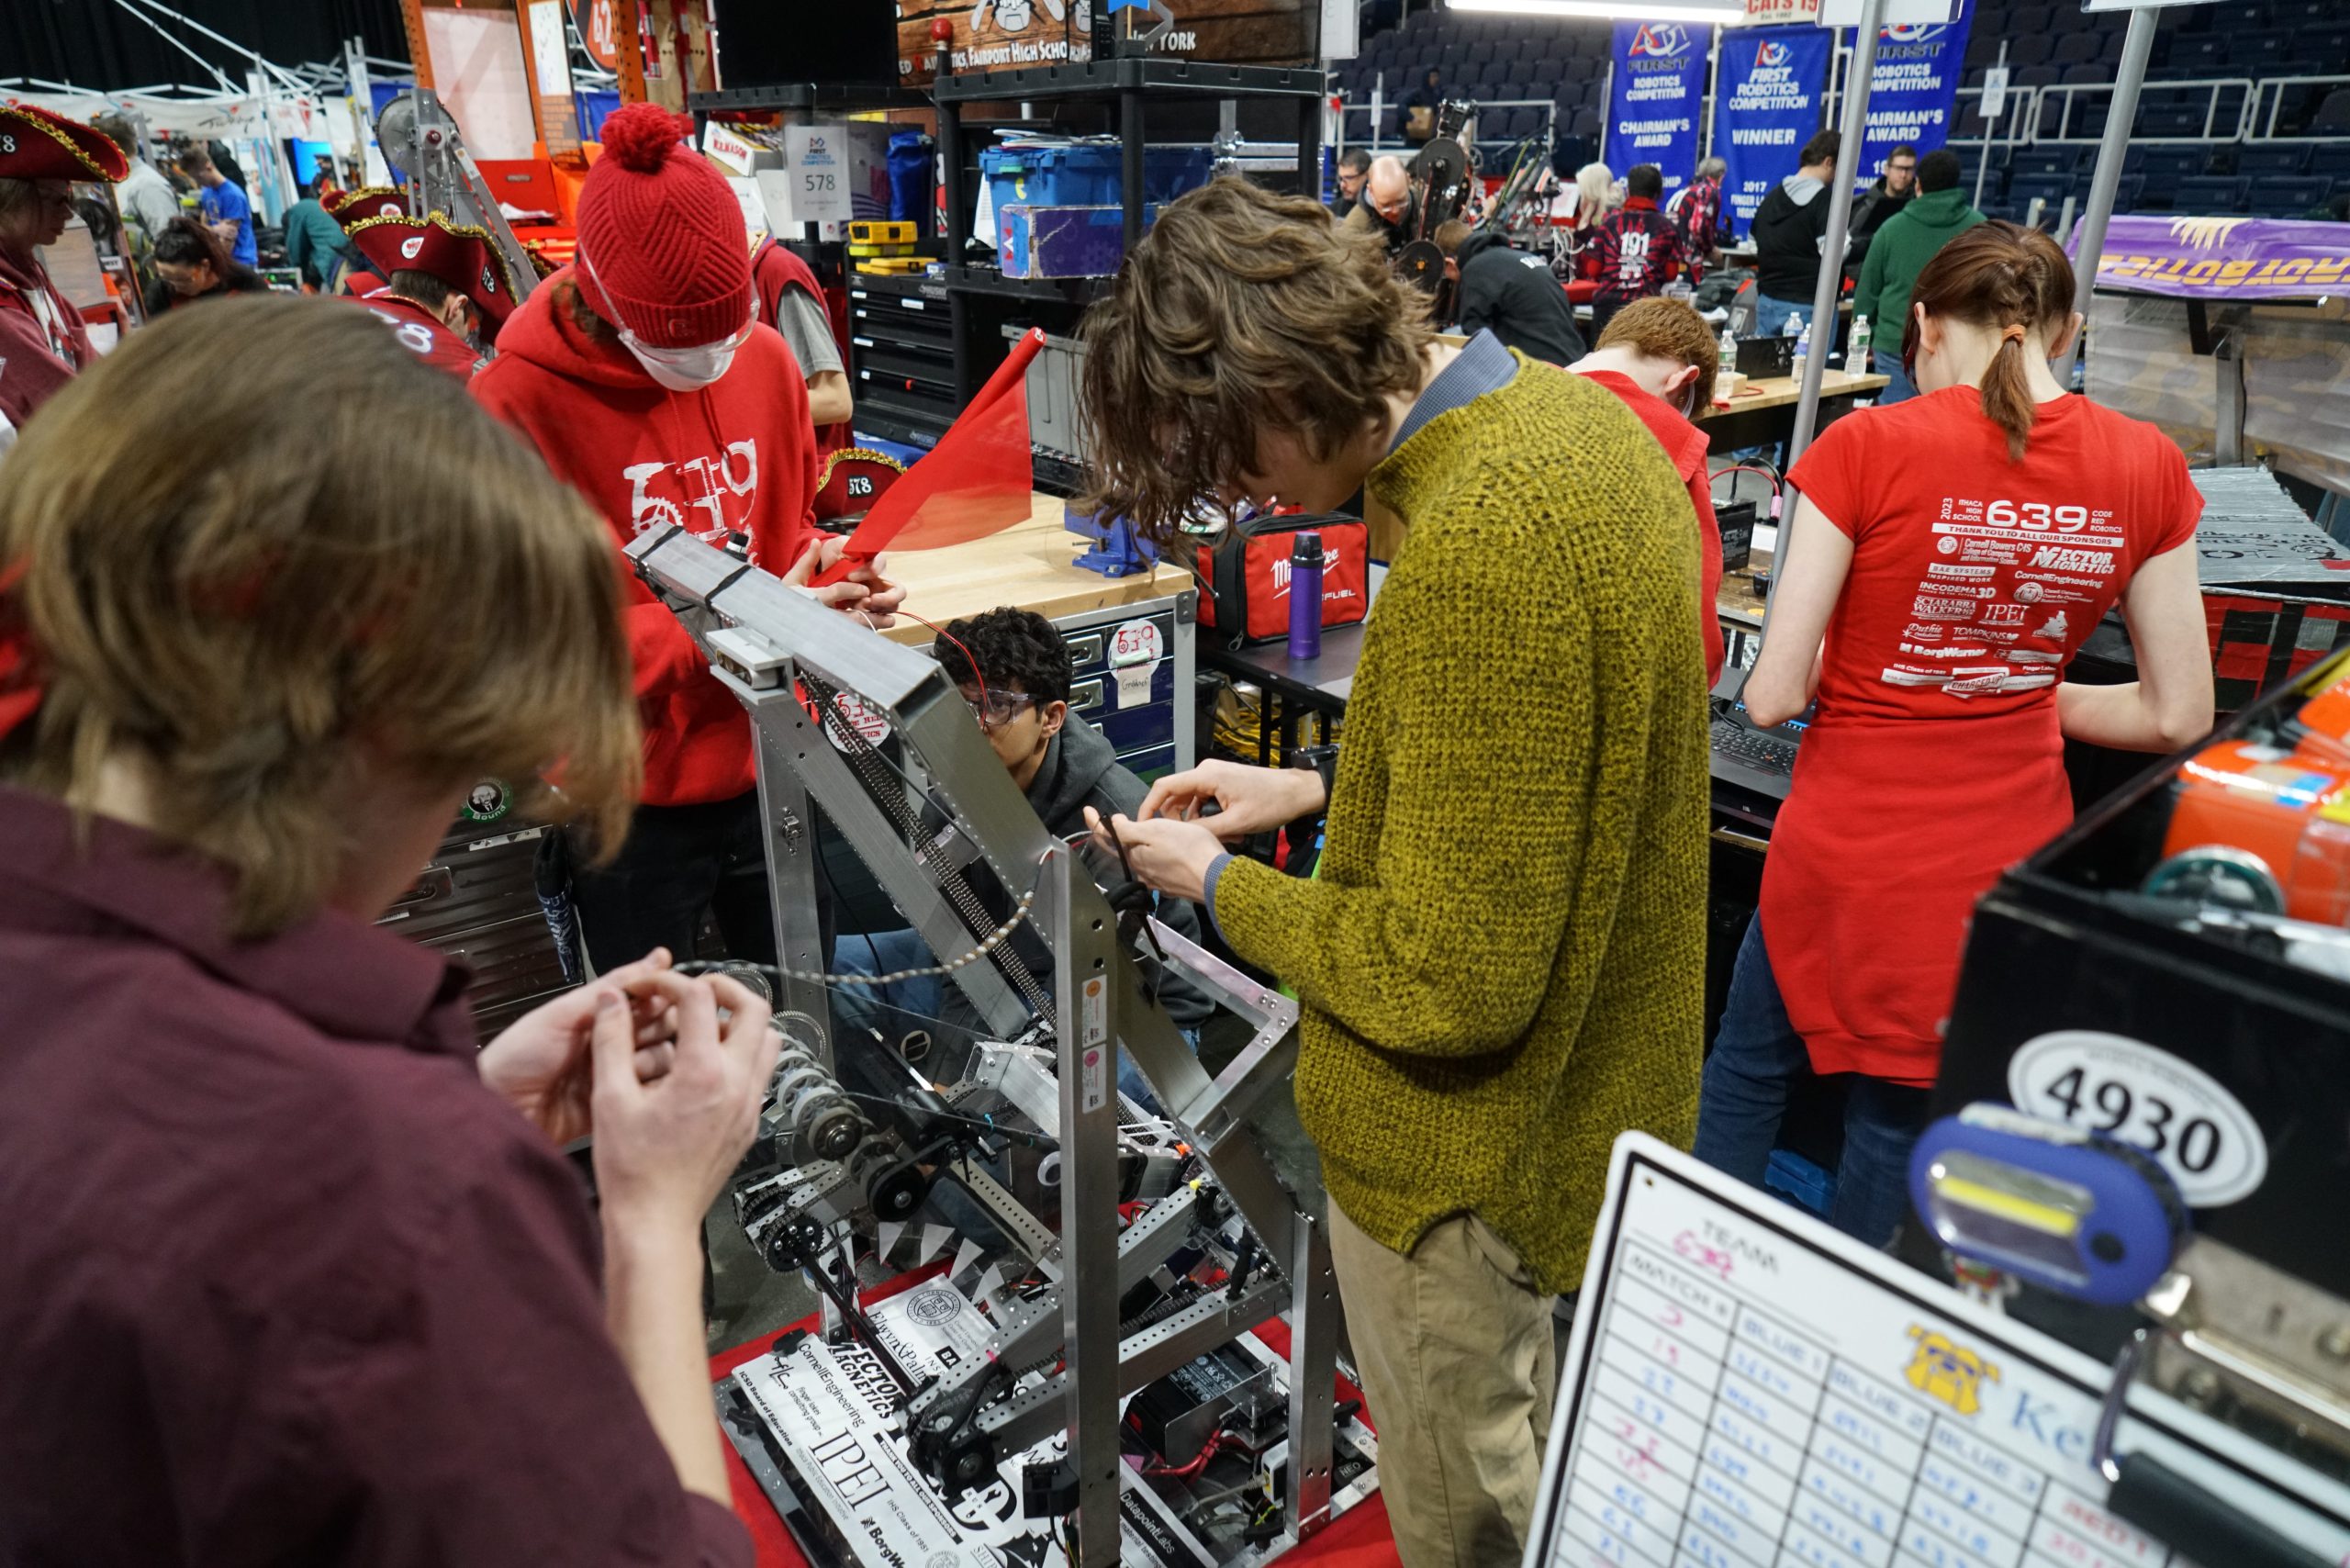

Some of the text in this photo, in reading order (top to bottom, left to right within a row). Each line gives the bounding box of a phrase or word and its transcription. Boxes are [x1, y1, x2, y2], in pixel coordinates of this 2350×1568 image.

[1160, 31, 1197, 51] YORK
[1873, 42, 1946, 60] IRST
[1628, 56, 1689, 73] FIRST
[1634, 75, 1681, 88] ROBOTICS
[1749, 67, 1793, 84] FIRST
[1626, 86, 1686, 102] COMPETITION
[1736, 82, 1799, 96] ROBOTICS
[1729, 95, 1809, 111] COMPETITION
[1619, 118, 1690, 135] CHAIRMAN'S
[1864, 109, 1944, 126] AIRMAN'S
[1634, 134, 1672, 148] AWARD
[1732, 129, 1796, 146] WINNER
[1866, 127, 1921, 142] AWARD
[805, 174, 836, 192] 578
[1743, 181, 1767, 193] 2017
[1618, 230, 1651, 258] 191
[2096, 255, 2350, 286] ROYBOTICS
[848, 476, 872, 495] 578
[1940, 497, 1953, 521] 2023
[1958, 498, 1984, 508] ITHACA
[1965, 507, 1983, 515] HIGH
[1952, 513, 1982, 522] SCHOOL
[1986, 499, 2088, 533] 639
[2090, 517, 2106, 525] RED
[2091, 510, 2113, 519] CODE
[1949, 526, 1983, 535] THANK
[1984, 528, 2004, 536] YOU
[2039, 533, 2060, 542] OUR
[2061, 535, 2112, 545] SPONSORS
[2089, 524, 2123, 533] ROBOTICS
[1964, 538, 1990, 548] Cornell
[1990, 539, 2016, 551] Bowers
[1927, 573, 1966, 582] INSPIRED
[1324, 588, 1357, 602] FUEL
[1984, 604, 2031, 622] IPEI
[2045, 1065, 2222, 1175] 4930
[1702, 1217, 1780, 1275] TEAM
[1630, 1254, 1711, 1307] MATCH
[1743, 1316, 1807, 1361] BLUE
[799, 1343, 866, 1428] CornellEngineering
[1832, 1368, 1900, 1418] BLUE
[737, 1371, 754, 1388] ICSD
[748, 1385, 767, 1407] Board
[767, 1412, 795, 1447] Education
[1937, 1427, 2009, 1481] BLUE
[808, 1427, 893, 1512] IPEI
[1339, 1461, 1362, 1478] NEO
[881, 1441, 901, 1462] THANK
[928, 1501, 958, 1539] SPONSORS
[886, 1497, 901, 1513] IHS
[894, 1509, 913, 1531] Class
[914, 1535, 931, 1554] 1951
[1120, 1491, 1176, 1554] DatapointLabs
[2063, 1499, 2131, 1546] RED
